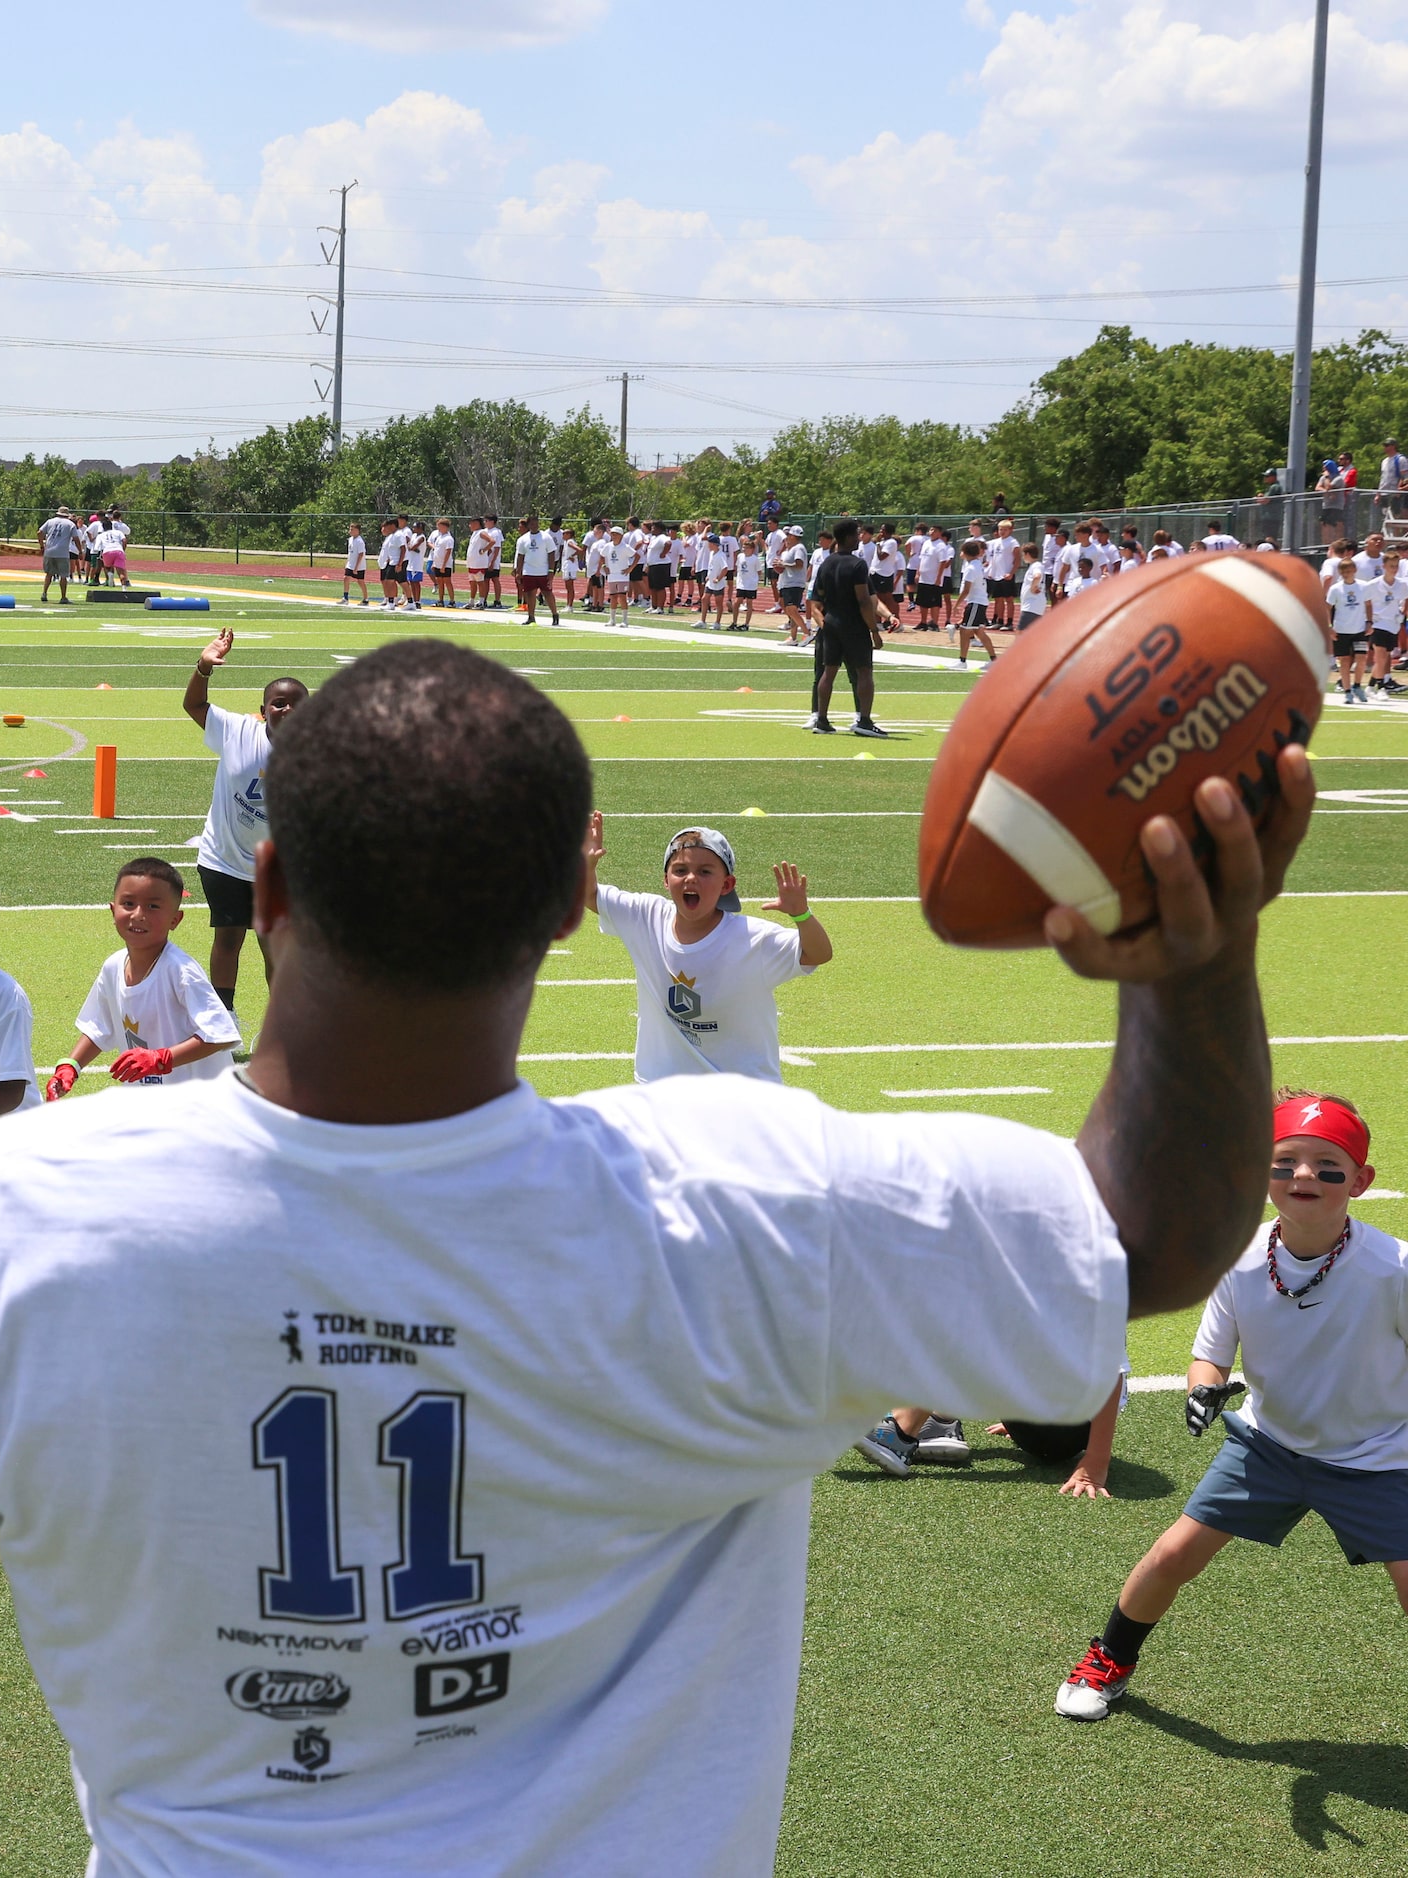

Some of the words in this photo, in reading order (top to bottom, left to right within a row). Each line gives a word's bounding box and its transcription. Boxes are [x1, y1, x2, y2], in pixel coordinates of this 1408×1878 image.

[1086, 624, 1182, 741] GST
[1113, 662, 1269, 802] Wilson
[234, 792, 254, 814] LIONS
[145, 1076, 162, 1084] DEN
[314, 1314, 366, 1334] TOM
[374, 1320, 455, 1347] DRAKE
[319, 1344, 418, 1365] ROOFING
[252, 1385, 485, 1624] 11
[217, 1626, 364, 1652] NEXTMOVE
[401, 1612, 522, 1656] evamor
[430, 1662, 498, 1707] D1
[266, 1766, 317, 1782] LIONS
